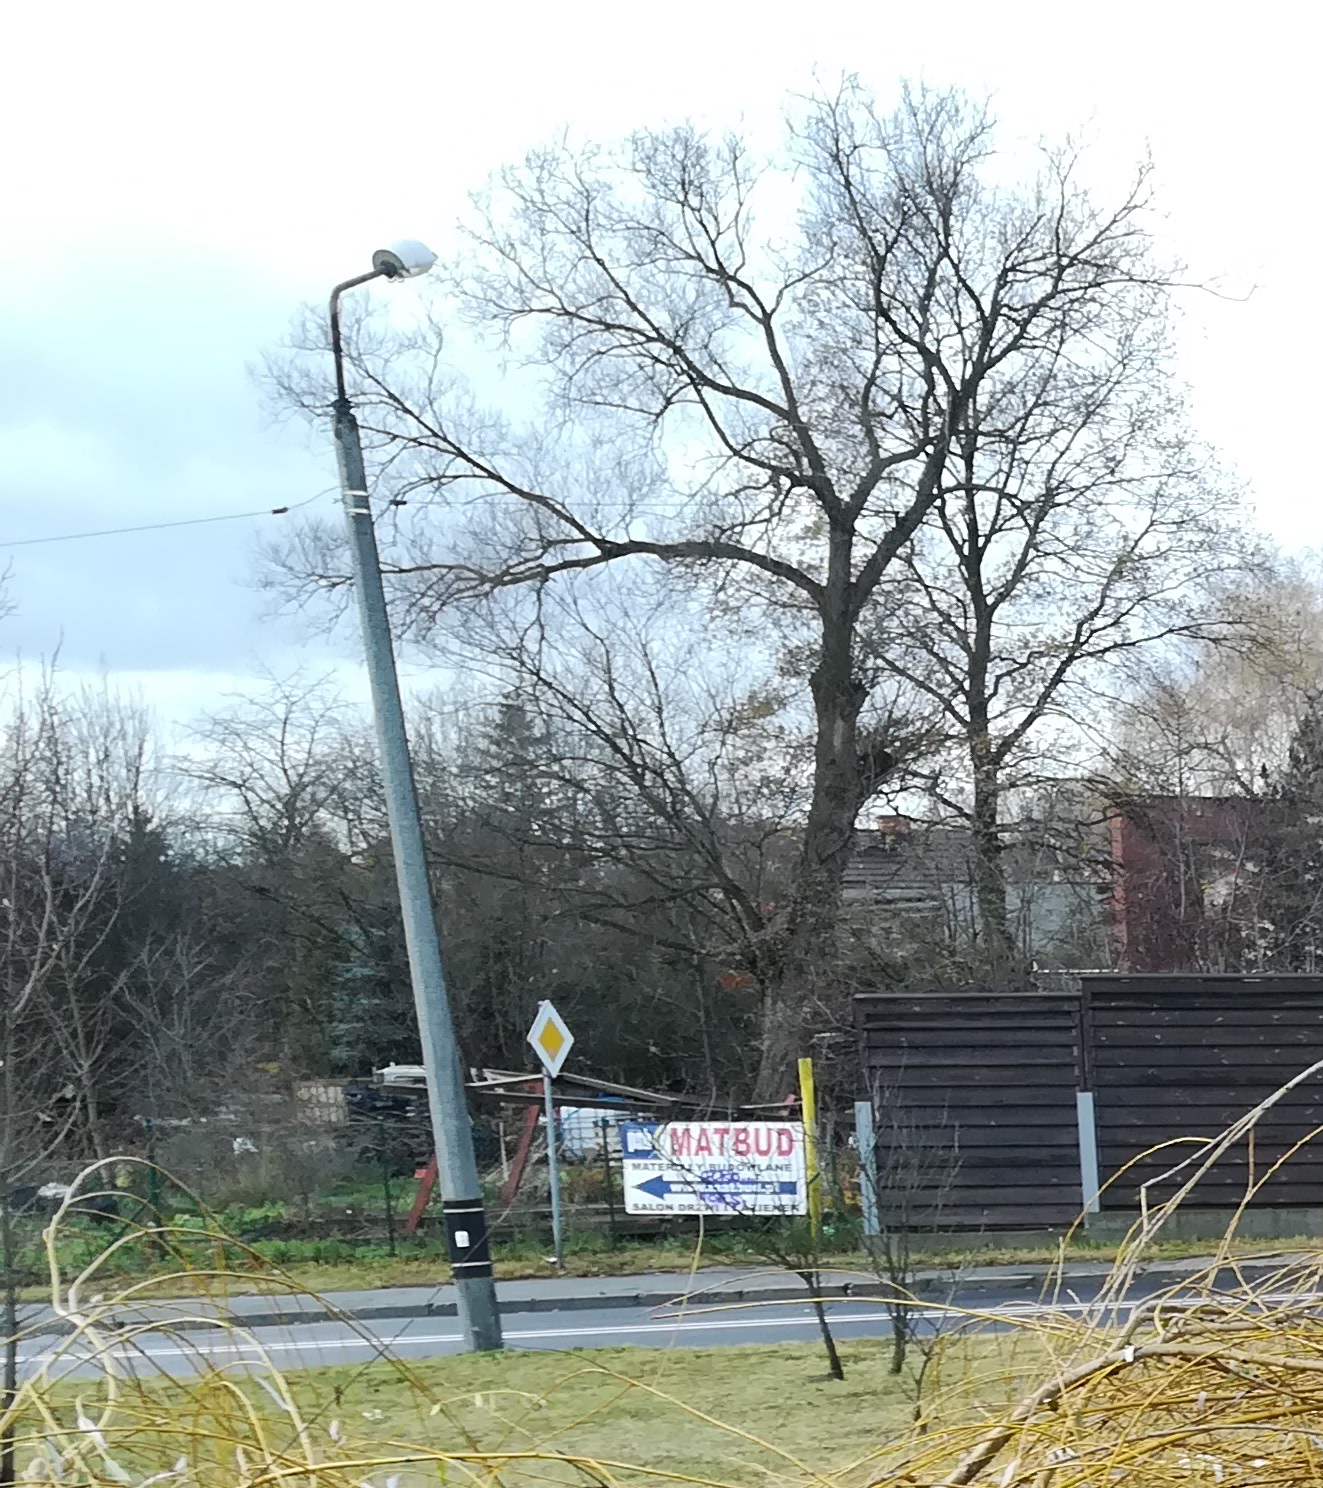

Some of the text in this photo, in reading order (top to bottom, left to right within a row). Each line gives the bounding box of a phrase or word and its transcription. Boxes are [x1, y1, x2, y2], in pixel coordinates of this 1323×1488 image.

[670, 1127, 794, 1156] MATBUD
[631, 1163, 706, 1172] MATERŁY
[632, 1203, 674, 1211] SALON
[678, 1203, 719, 1212] DRZWI
